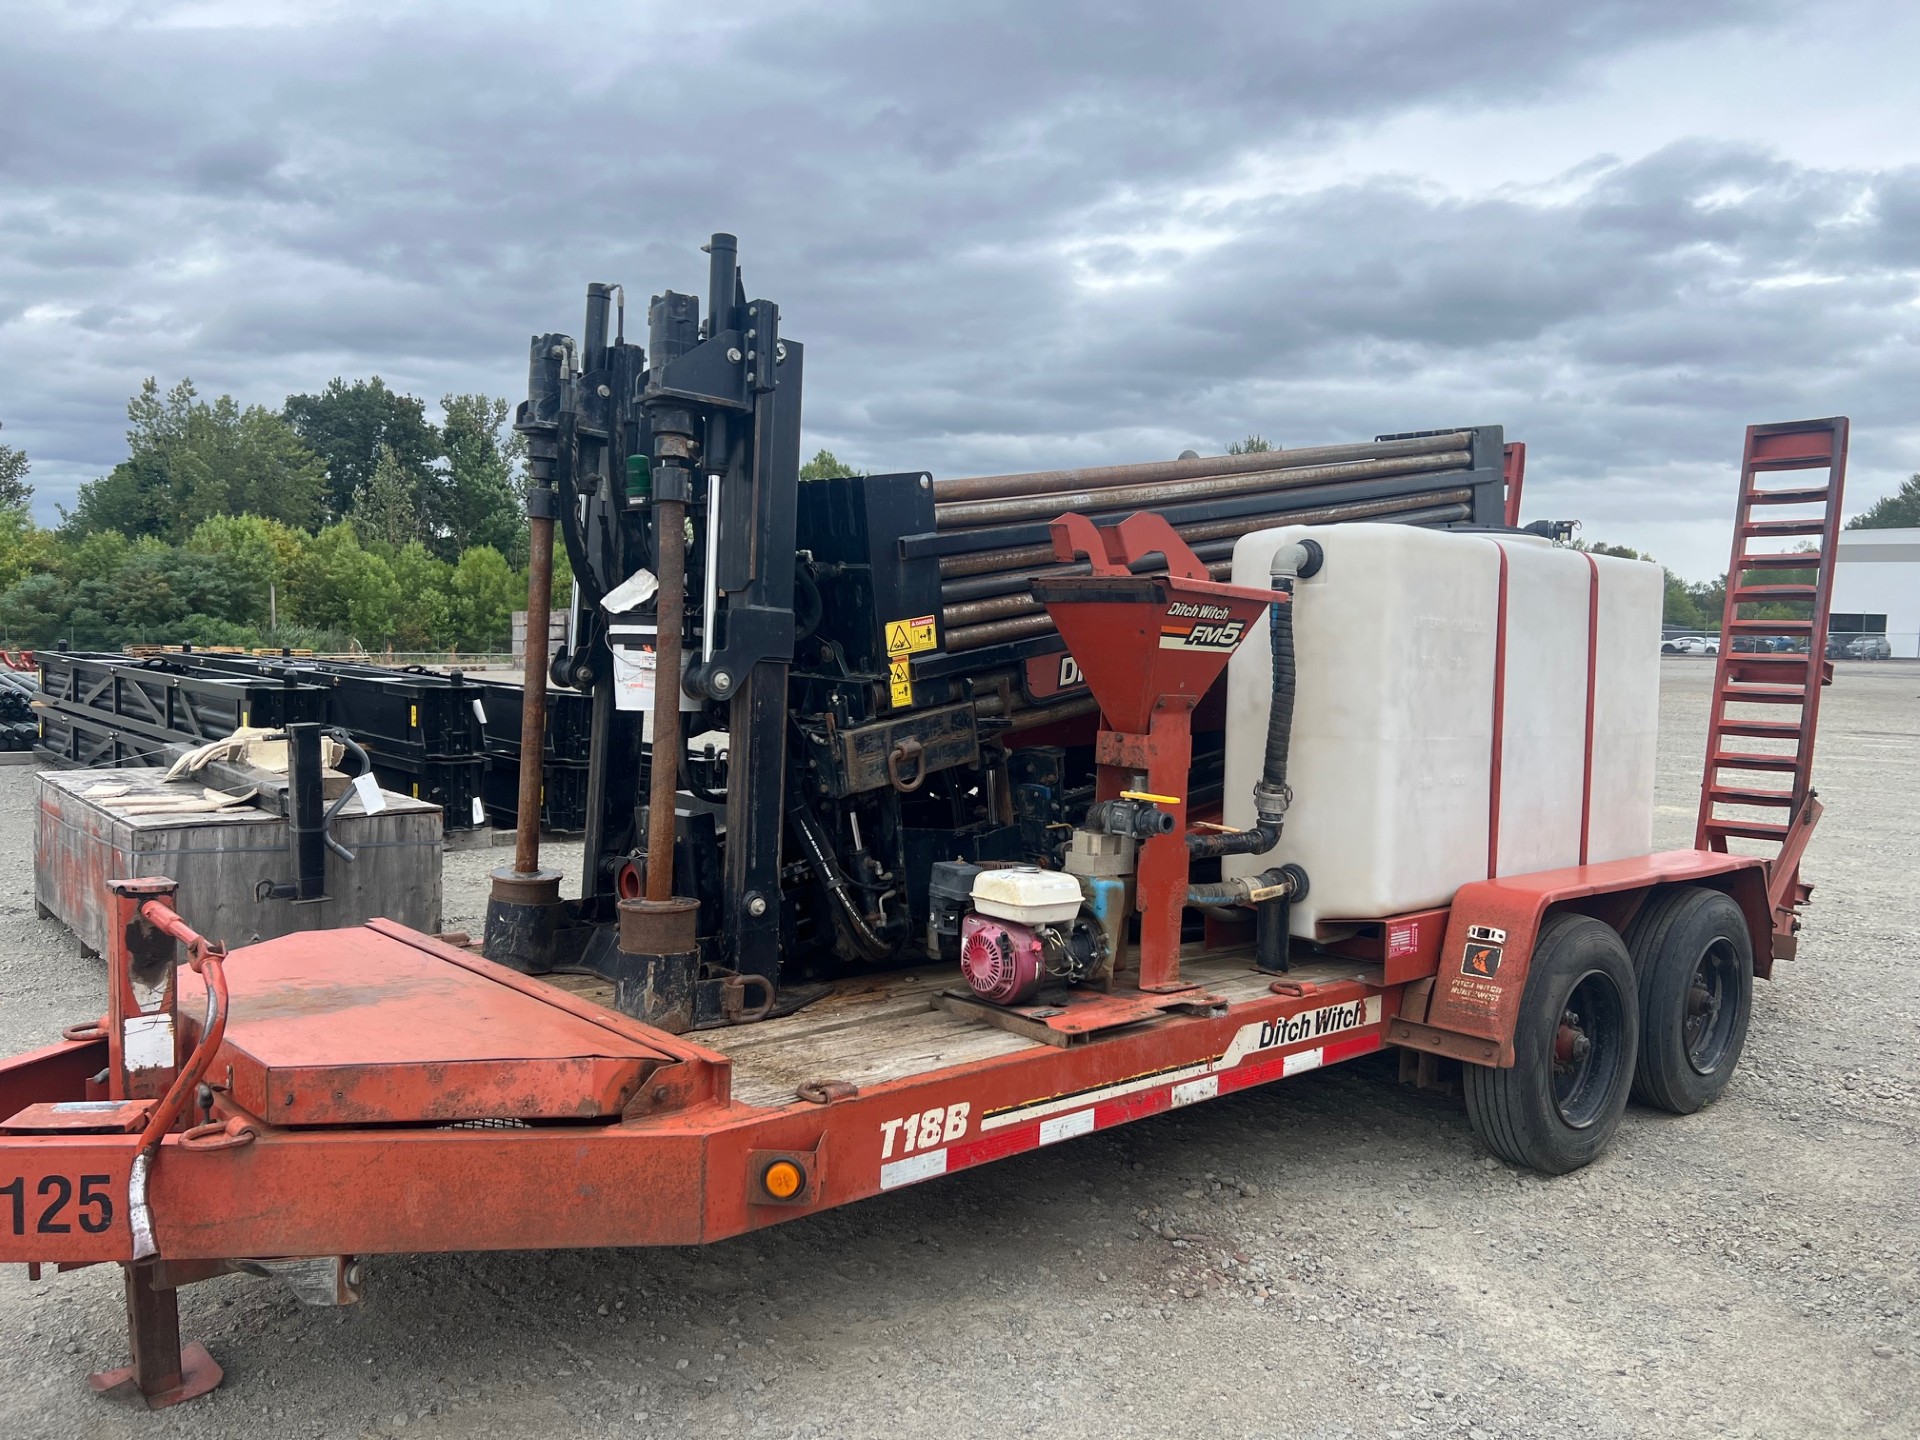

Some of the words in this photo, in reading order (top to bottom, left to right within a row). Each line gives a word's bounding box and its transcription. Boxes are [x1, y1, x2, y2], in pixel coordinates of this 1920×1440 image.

[915, 618, 933, 626] DANGER
[1167, 602, 1199, 617] Ditch
[1198, 604, 1229, 620] Witch
[1188, 622, 1244, 644] FM5
[1259, 1014, 1311, 1049] Ditch
[1315, 1001, 1361, 1035] Witch
[880, 1102, 970, 1159] T18B
[0, 1174, 113, 1235] 125
